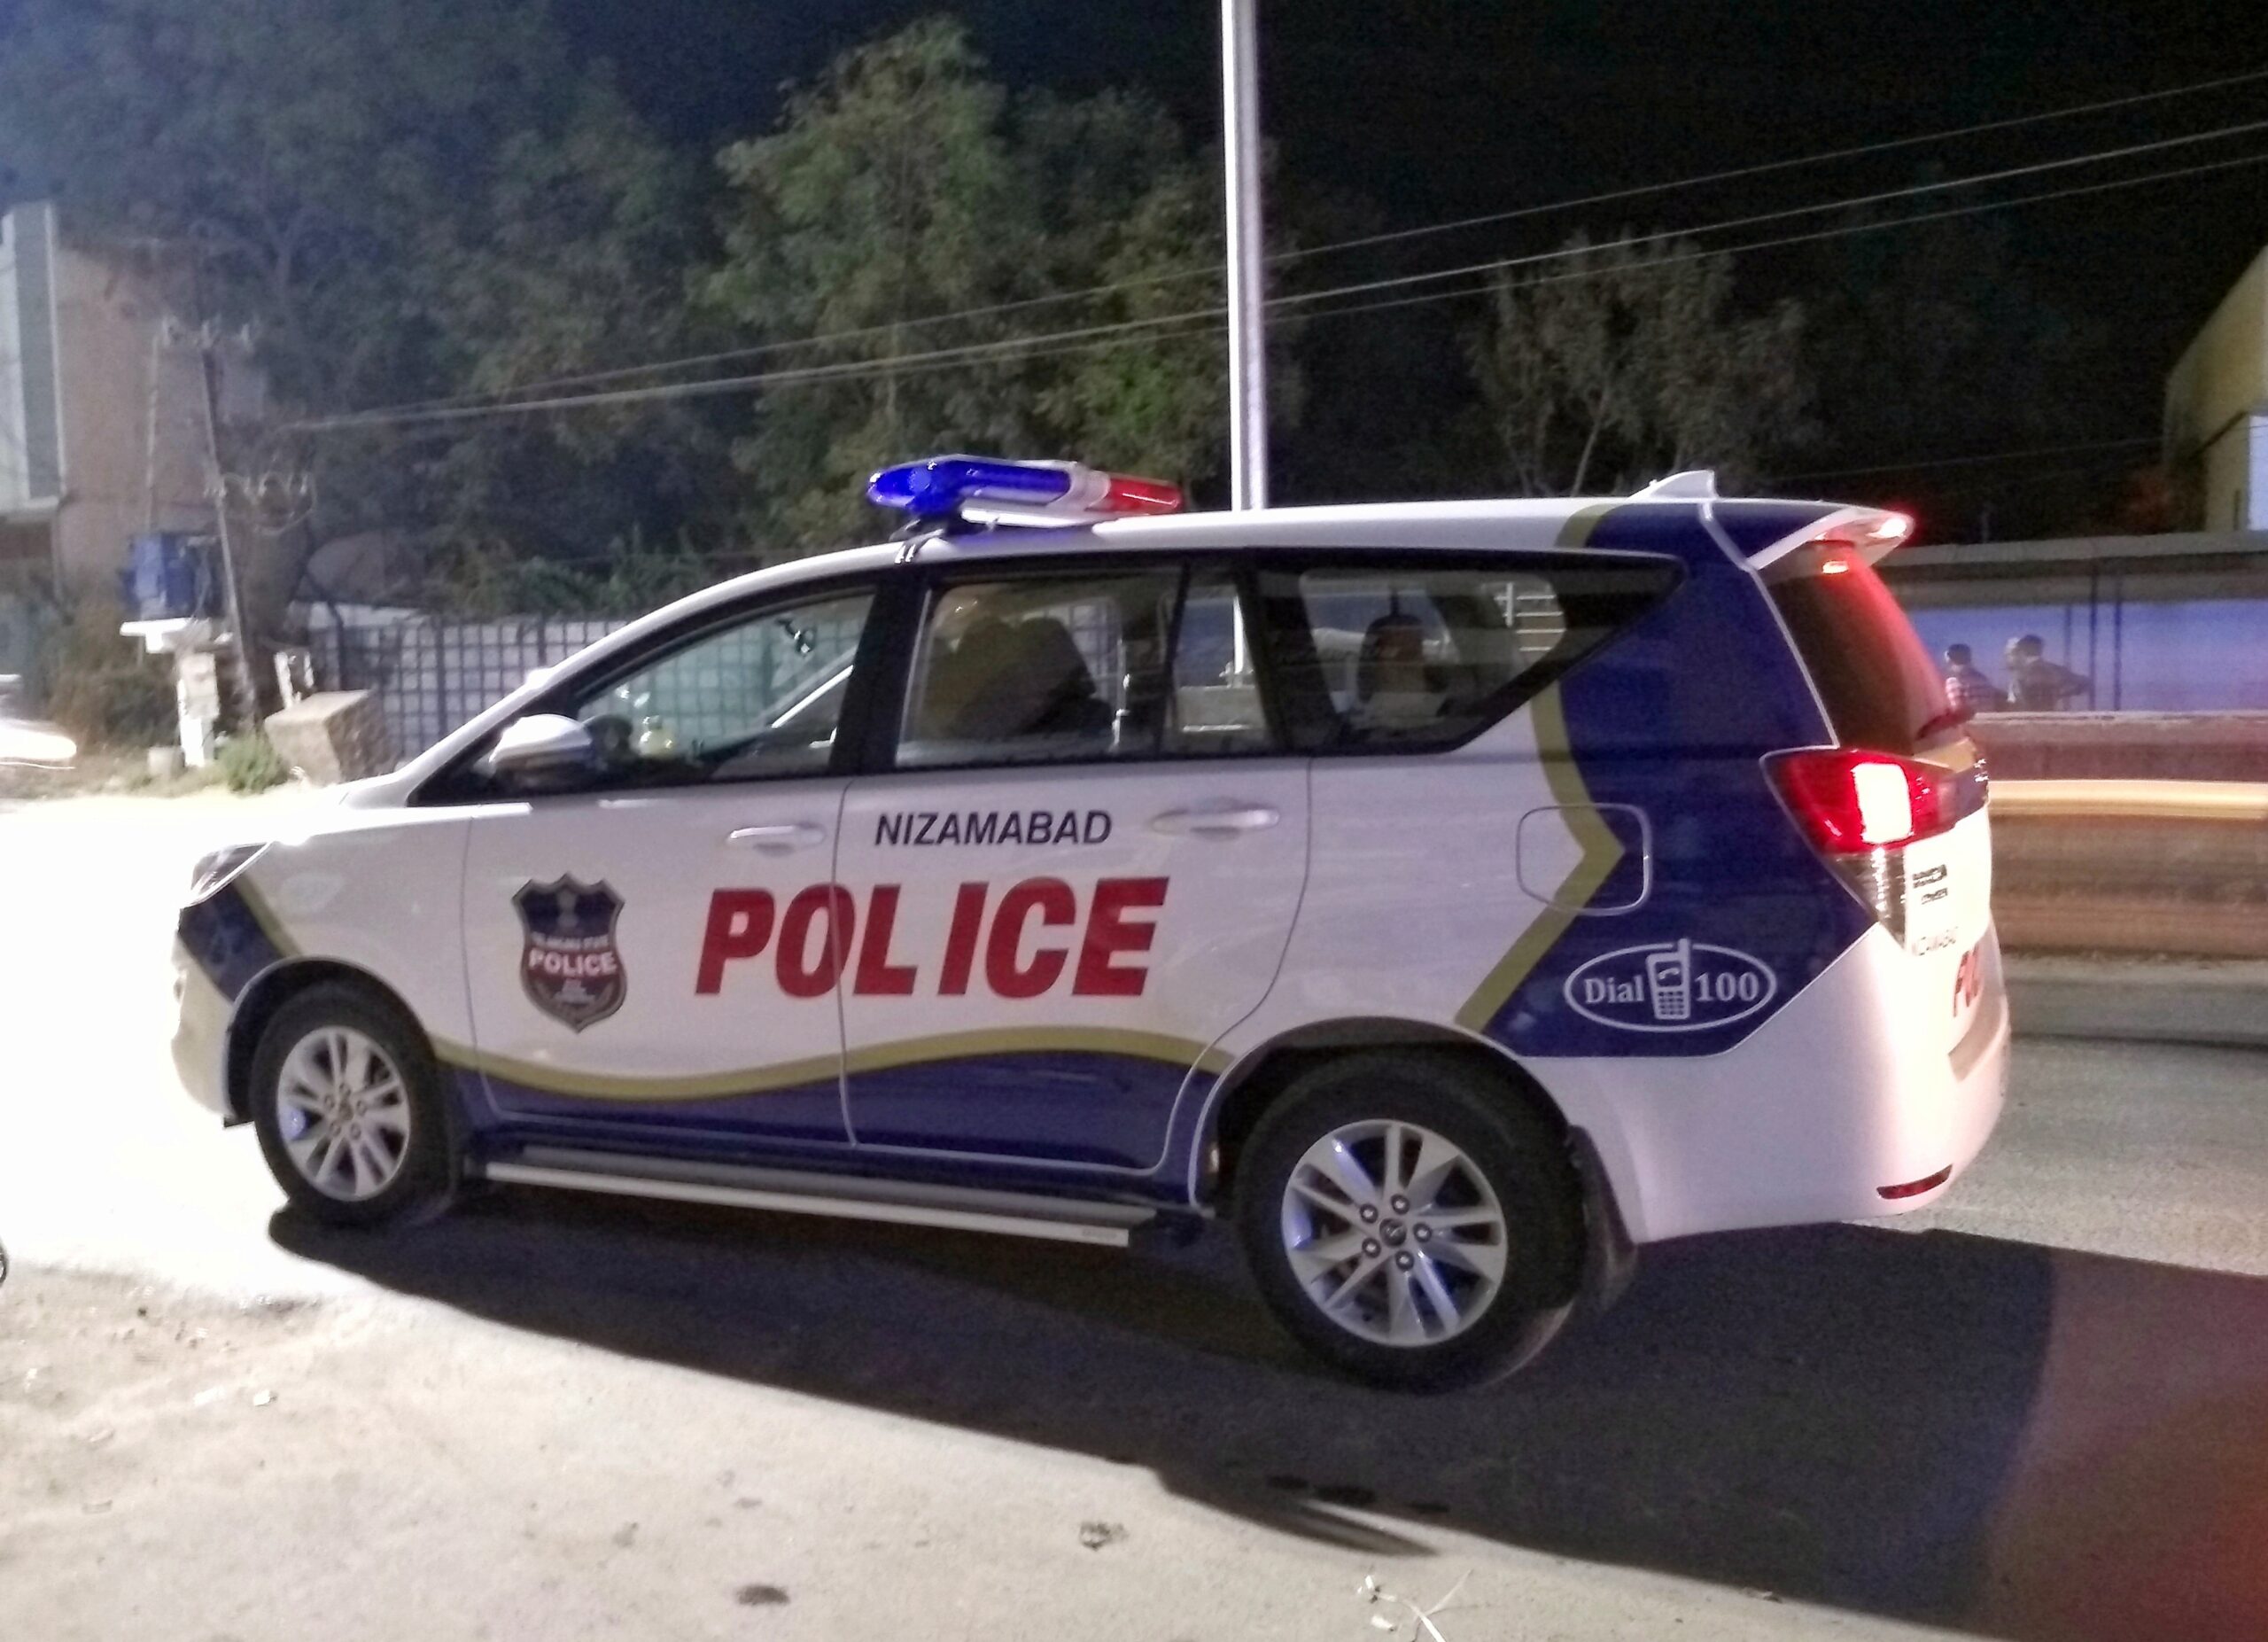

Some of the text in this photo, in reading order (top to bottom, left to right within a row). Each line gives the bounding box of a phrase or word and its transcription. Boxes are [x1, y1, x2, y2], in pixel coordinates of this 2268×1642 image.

[874, 809, 1113, 846] NIZAMABAD
[695, 876, 1169, 999] POLICE
[529, 948, 617, 977] POLICE
[1584, 972, 1759, 1004] Dial 100
